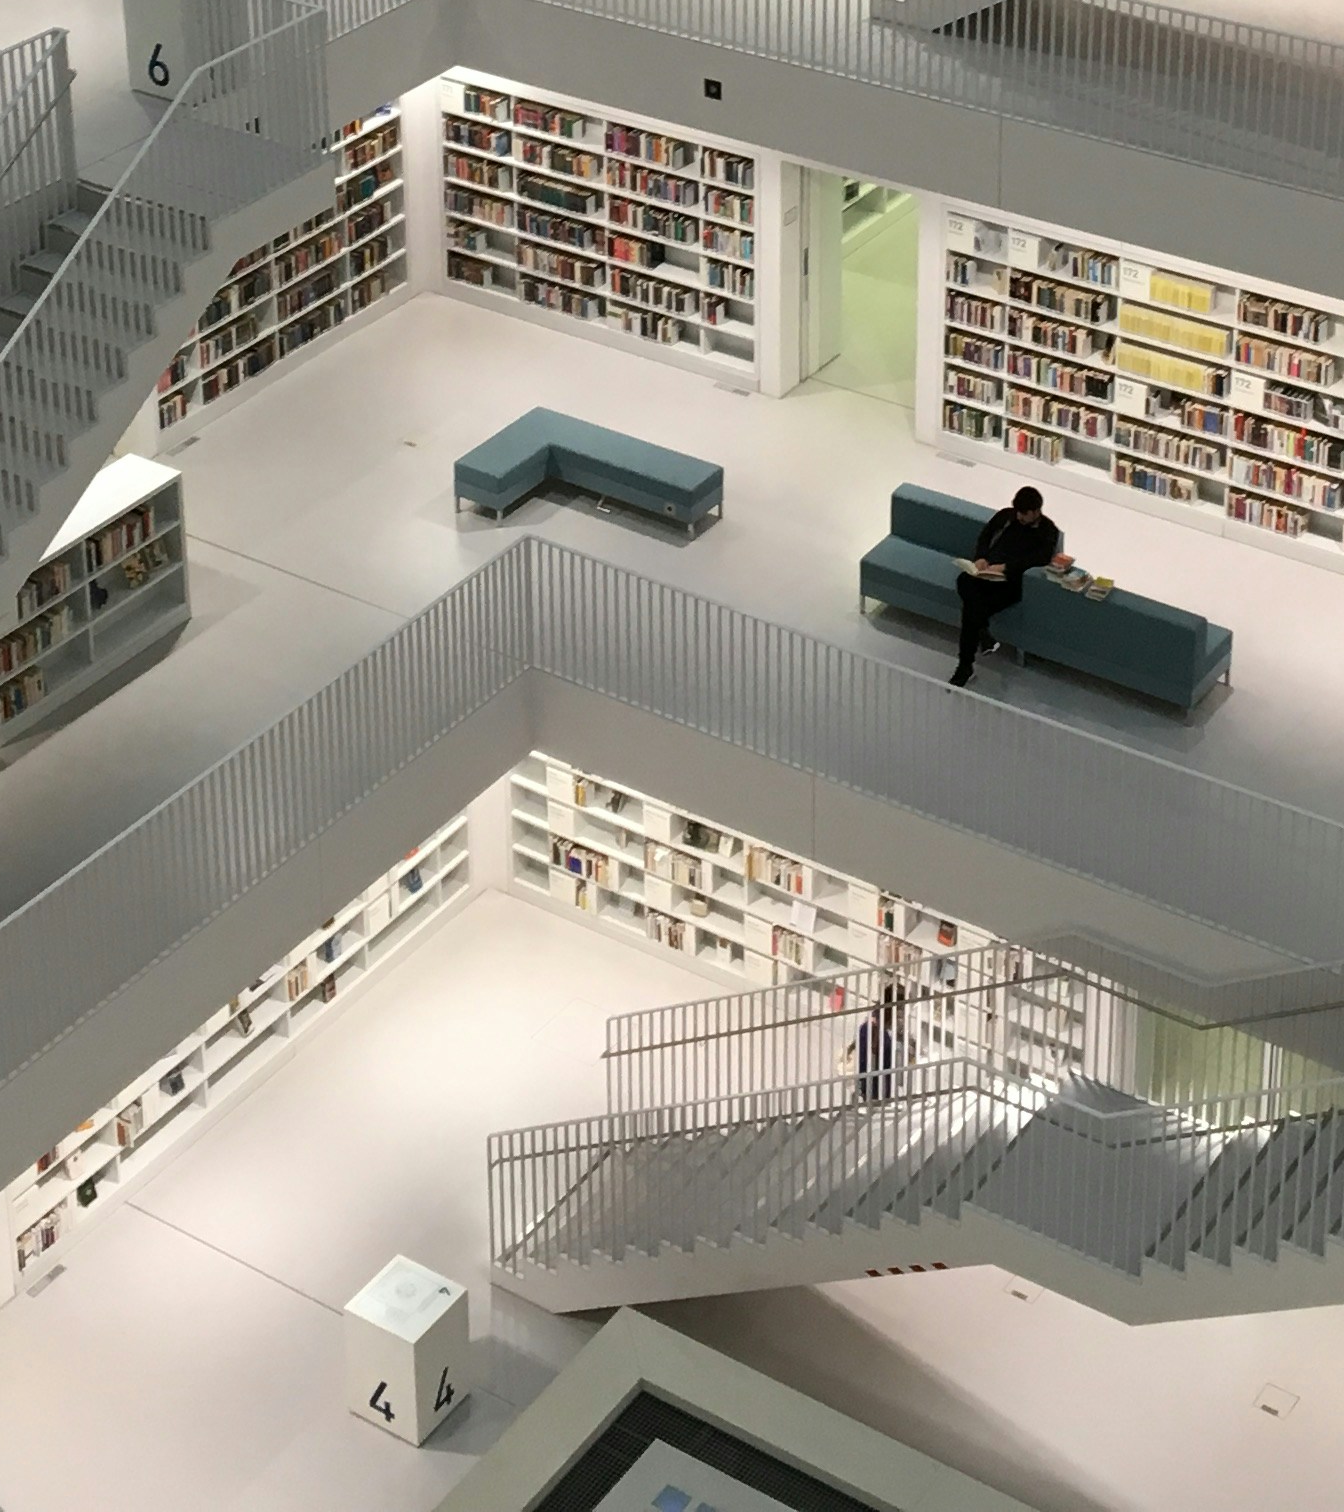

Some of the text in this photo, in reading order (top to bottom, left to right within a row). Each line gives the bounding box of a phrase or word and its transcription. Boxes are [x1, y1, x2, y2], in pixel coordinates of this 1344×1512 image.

[148, 43, 170, 87] 6
[369, 1381, 395, 1423] 4
[433, 1366, 455, 1412] 4
